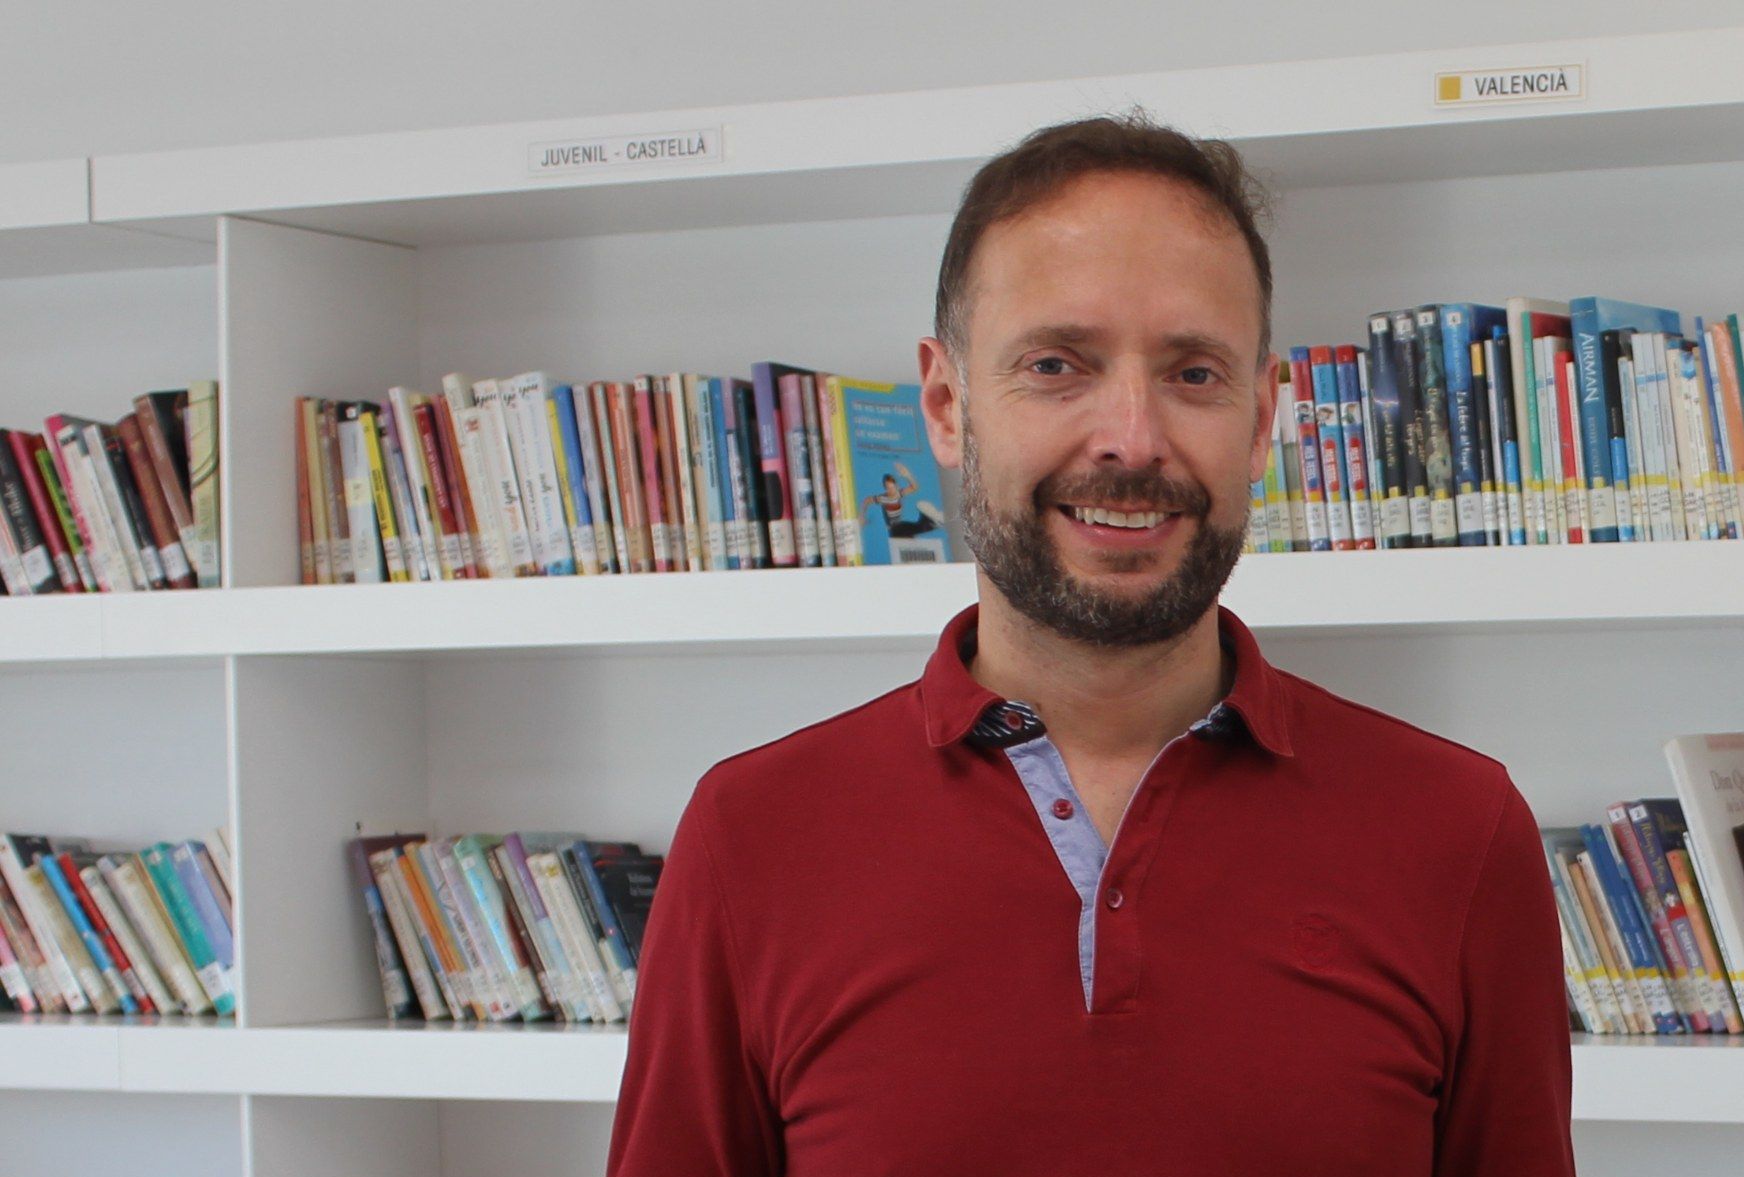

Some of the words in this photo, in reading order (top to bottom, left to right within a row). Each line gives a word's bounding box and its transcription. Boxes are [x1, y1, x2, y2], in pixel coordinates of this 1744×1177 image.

[1475, 67, 1567, 95] VALENCIÀ
[541, 145, 607, 166] JUVENIL
[627, 132, 706, 160] CASTELLÀ
[1578, 332, 1600, 403] AIRMAN
